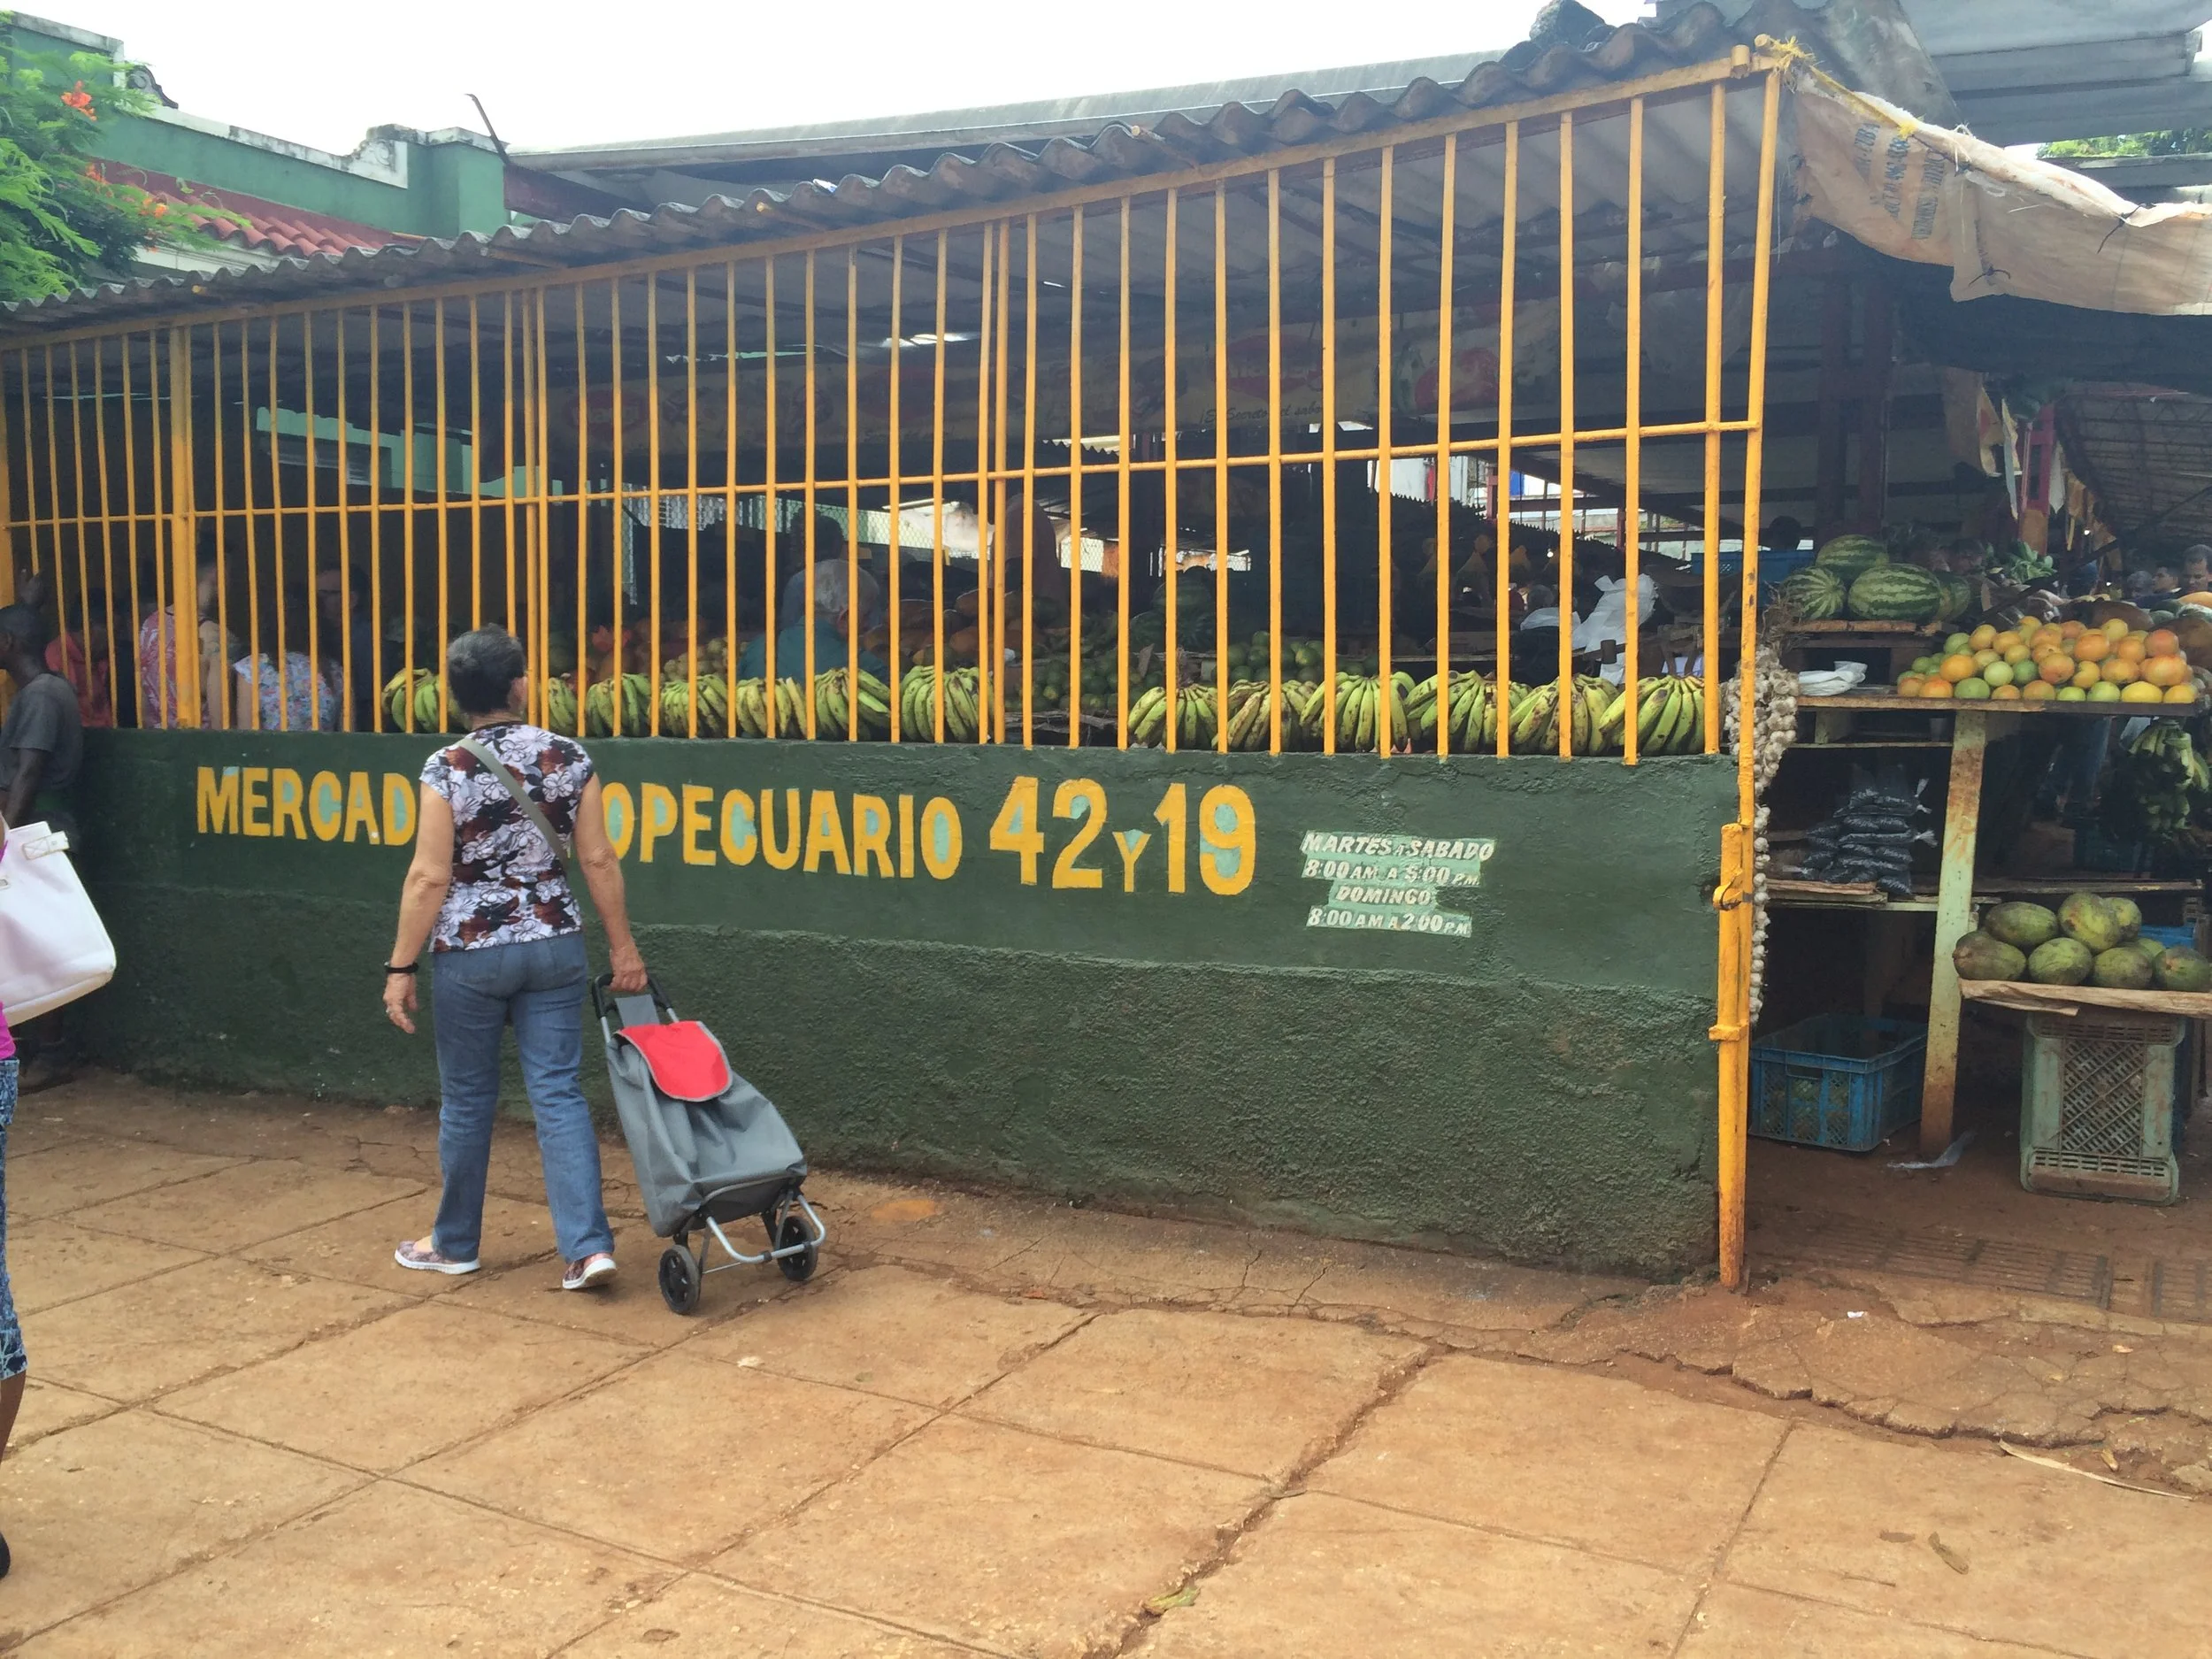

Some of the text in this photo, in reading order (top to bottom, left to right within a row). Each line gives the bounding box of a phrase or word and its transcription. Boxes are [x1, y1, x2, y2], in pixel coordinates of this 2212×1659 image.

[196, 765, 417, 845] MERCAD
[989, 775, 1108, 888] 42
[1112, 829, 1151, 893] Y
[1153, 782, 1256, 895] 19
[1301, 832, 1393, 856] MARTES
[1405, 838, 1495, 862] SABADO
[1304, 858, 1350, 879] 8:00
[1386, 867, 1398, 880] A
[1404, 864, 1451, 886] 5:00
[1335, 885, 1432, 906] DOMINGO
[1308, 908, 1353, 926] 8:00
[1387, 914, 1399, 928] A
